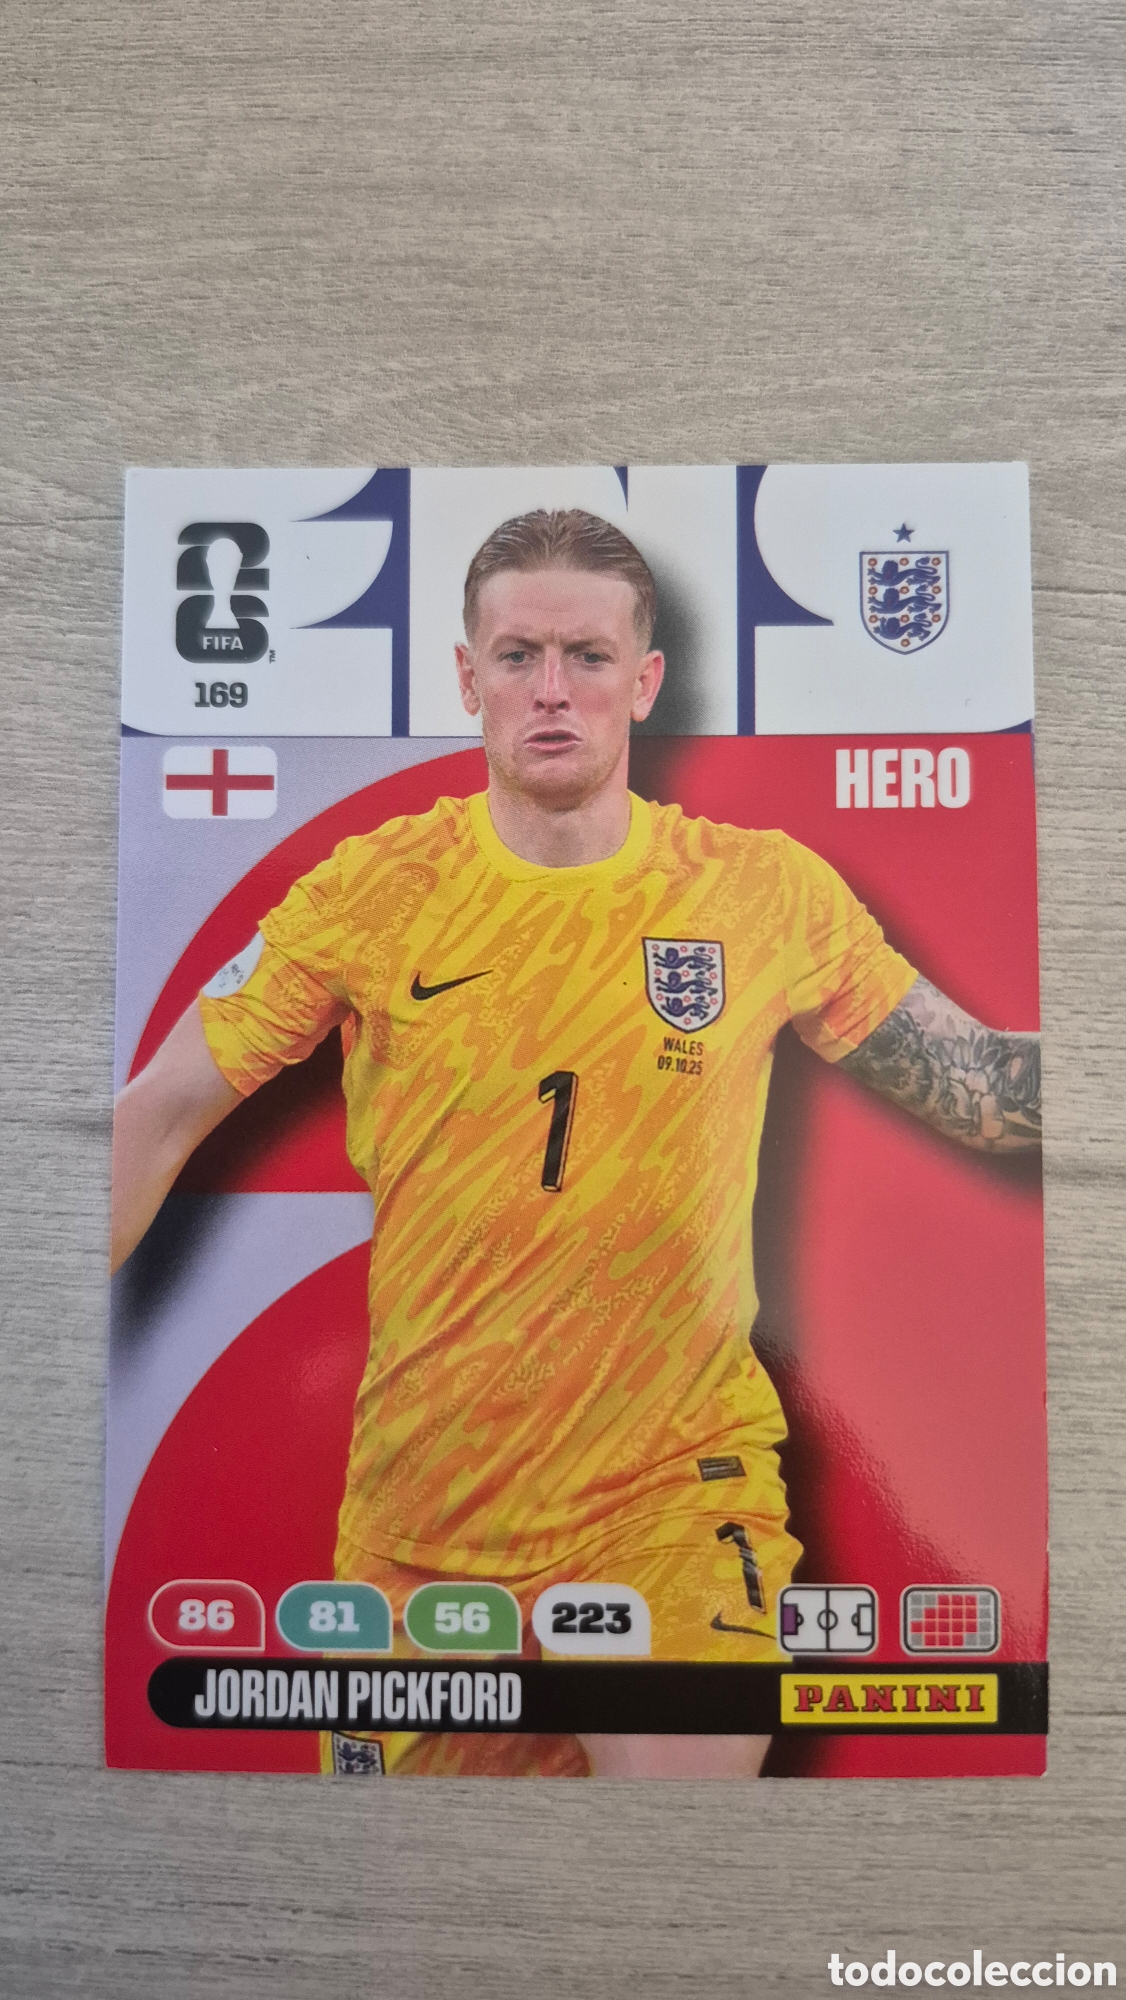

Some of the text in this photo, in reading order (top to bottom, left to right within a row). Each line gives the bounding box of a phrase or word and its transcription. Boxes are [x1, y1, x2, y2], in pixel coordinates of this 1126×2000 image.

[202, 636, 244, 651] FIFA
[194, 681, 249, 709] 169
[835, 746, 971, 809] HERO
[663, 1036, 704, 1057] WALES
[657, 1054, 704, 1076] 09.10.25
[538, 1070, 579, 1192] 1
[715, 1521, 767, 1615] 1
[178, 1598, 235, 1632] 86
[308, 1600, 361, 1633] 81
[434, 1601, 491, 1634] 56
[551, 1601, 632, 1635] 223
[194, 1667, 523, 1721] JORDAN PICKFORD
[794, 1684, 986, 1713] PANINI
